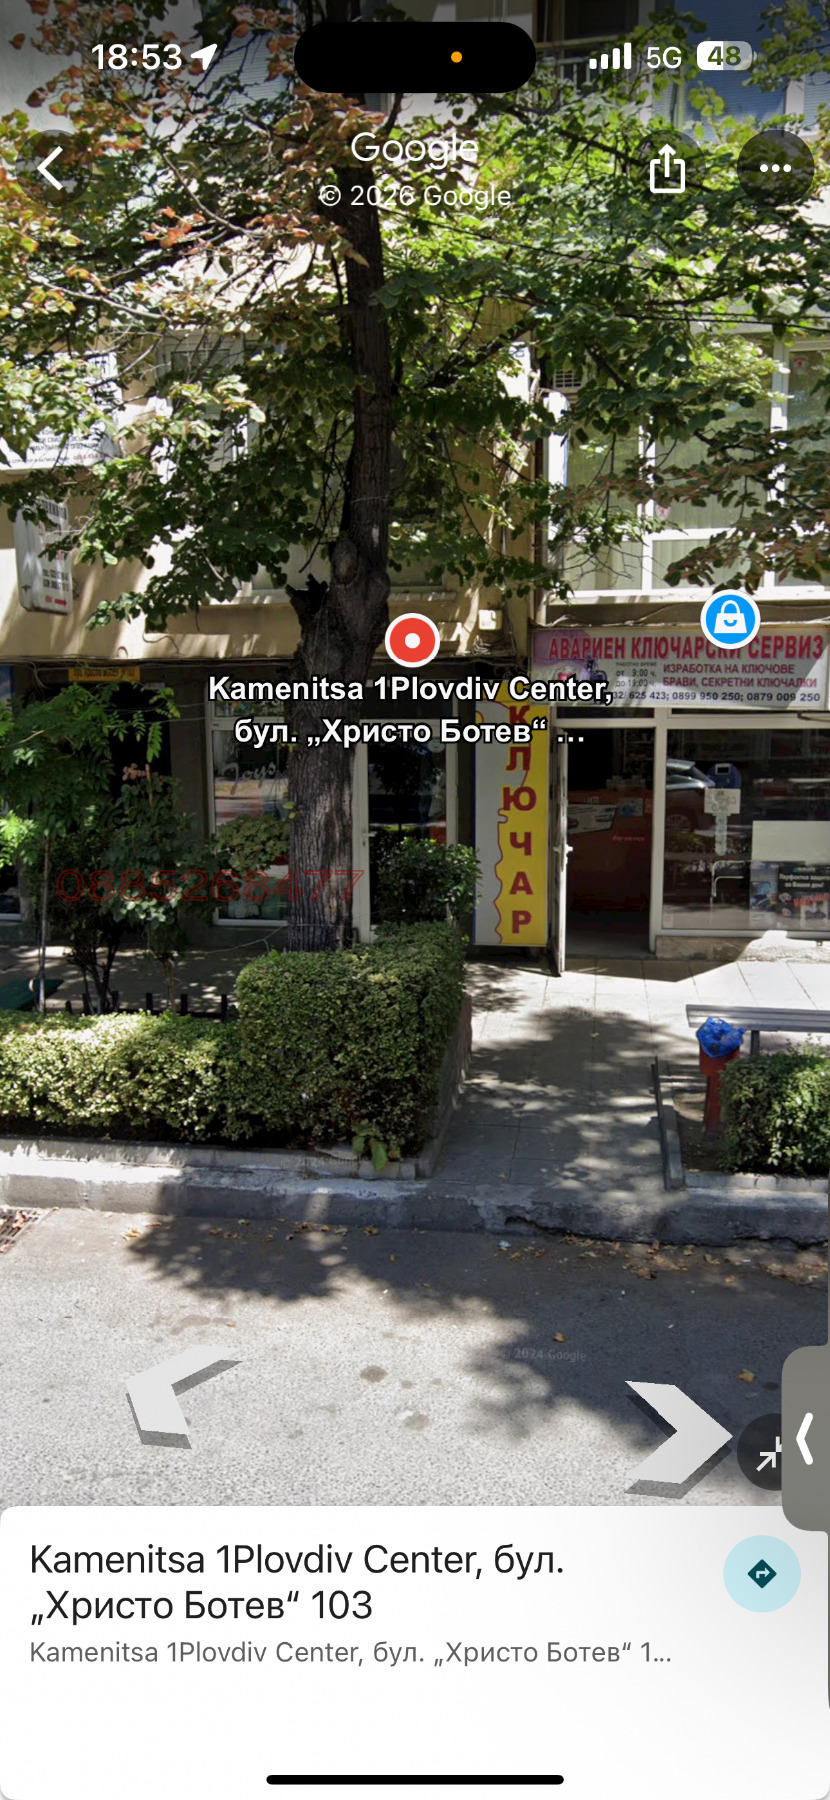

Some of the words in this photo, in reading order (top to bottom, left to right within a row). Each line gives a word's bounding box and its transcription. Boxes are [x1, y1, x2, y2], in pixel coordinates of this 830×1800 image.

[548, 637, 626, 659] АВАРИЕН
[747, 634, 825, 660] СЕРВИЗ
[632, 668, 649, 677] 9:00
[663, 663, 722, 674] ИЗРАБОТКА
[725, 663, 739, 673] НА
[741, 663, 795, 674] КЛЮЧОВЕ
[615, 680, 626, 689] до
[628, 678, 648, 688] 19:00
[663, 677, 699, 688] БРАВИ,
[701, 677, 754, 688] СЕКРЕТНИ
[756, 677, 817, 688] КЛЮЧАЛКИ
[629, 691, 647, 700] 625
[649, 691, 670, 701] 423;
[672, 691, 697, 700] 0899
[700, 692, 719, 700] 950
[722, 692, 744, 701] 250;
[747, 692, 773, 701] 0879
[776, 692, 796, 701] 009
[800, 692, 821, 701] 250
[502, 705, 537, 934] КЛЮЧАР
